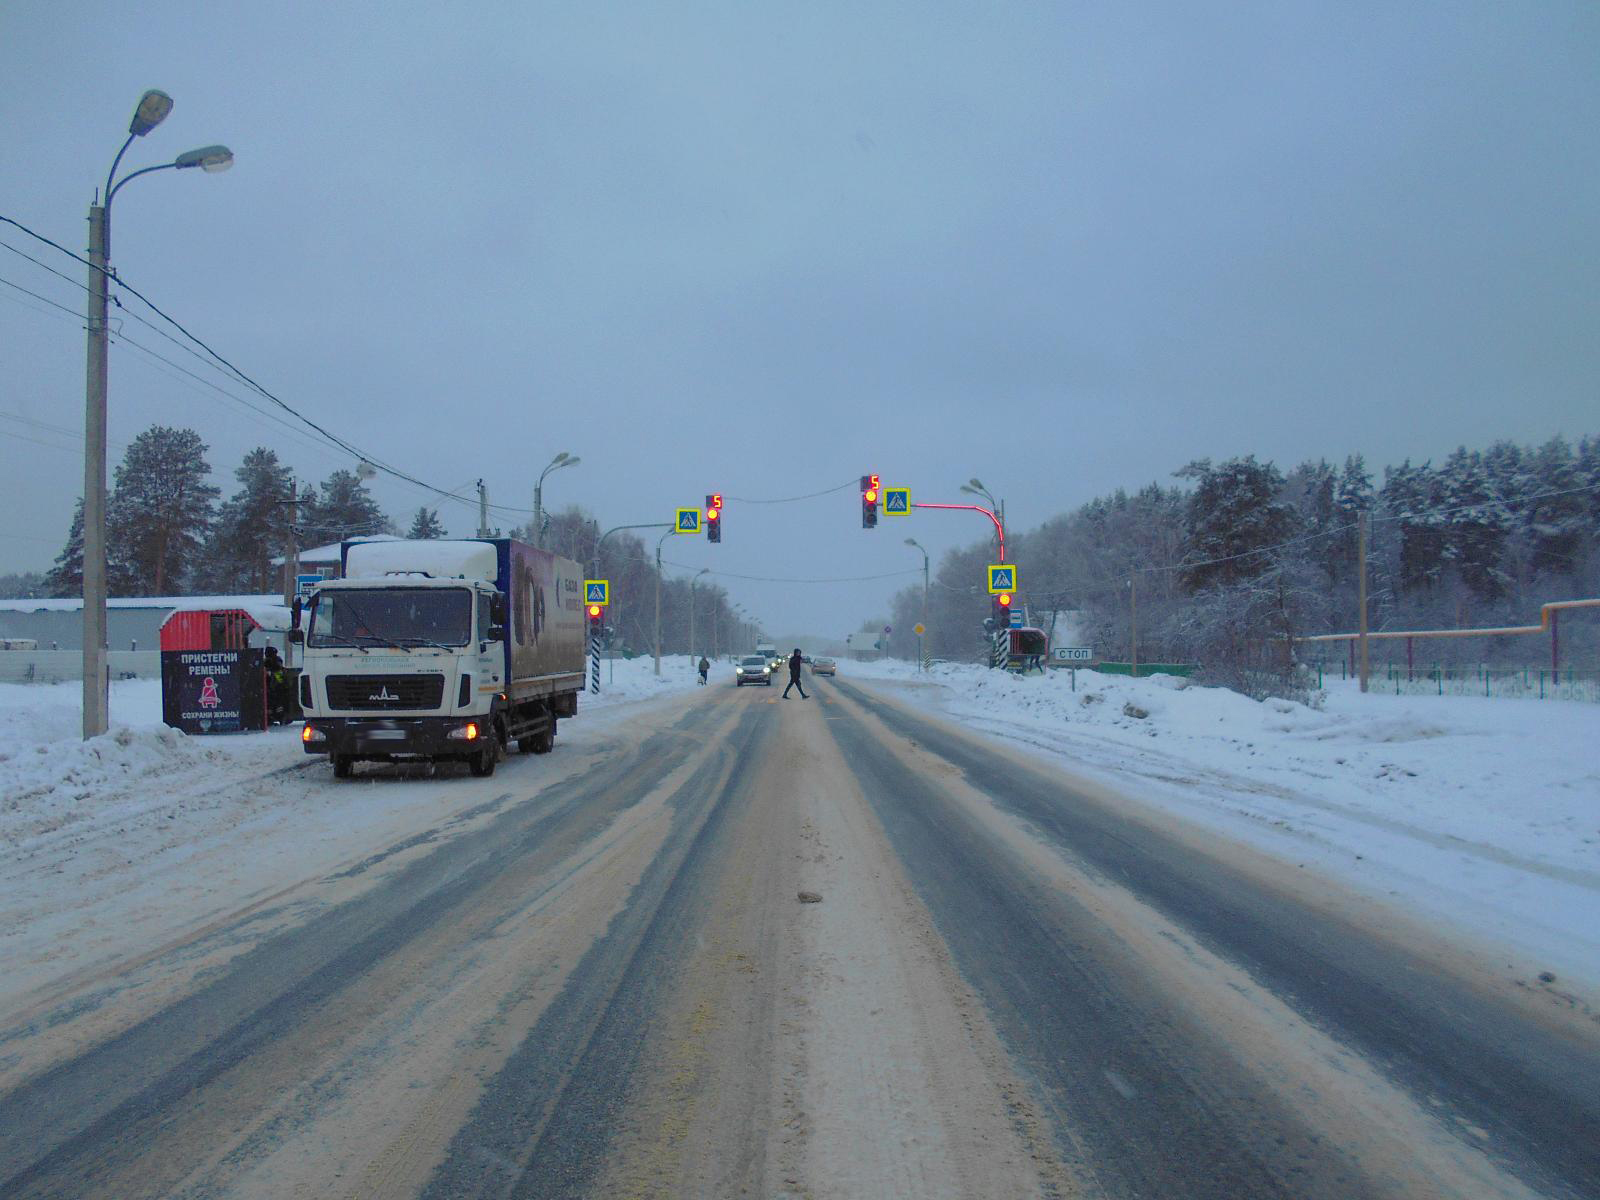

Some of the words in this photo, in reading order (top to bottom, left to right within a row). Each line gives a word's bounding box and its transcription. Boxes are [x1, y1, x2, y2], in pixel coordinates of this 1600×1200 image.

[871, 475, 880, 490] 5
[713, 495, 721, 508] 5
[181, 653, 238, 664] ПРИСТЕГНИ
[1059, 650, 1089, 659] СТОП
[189, 664, 231, 675] РЕМЕНЬ!
[182, 711, 212, 719] СОХРАНИ
[214, 711, 239, 719] ЖИЗНЬ!
